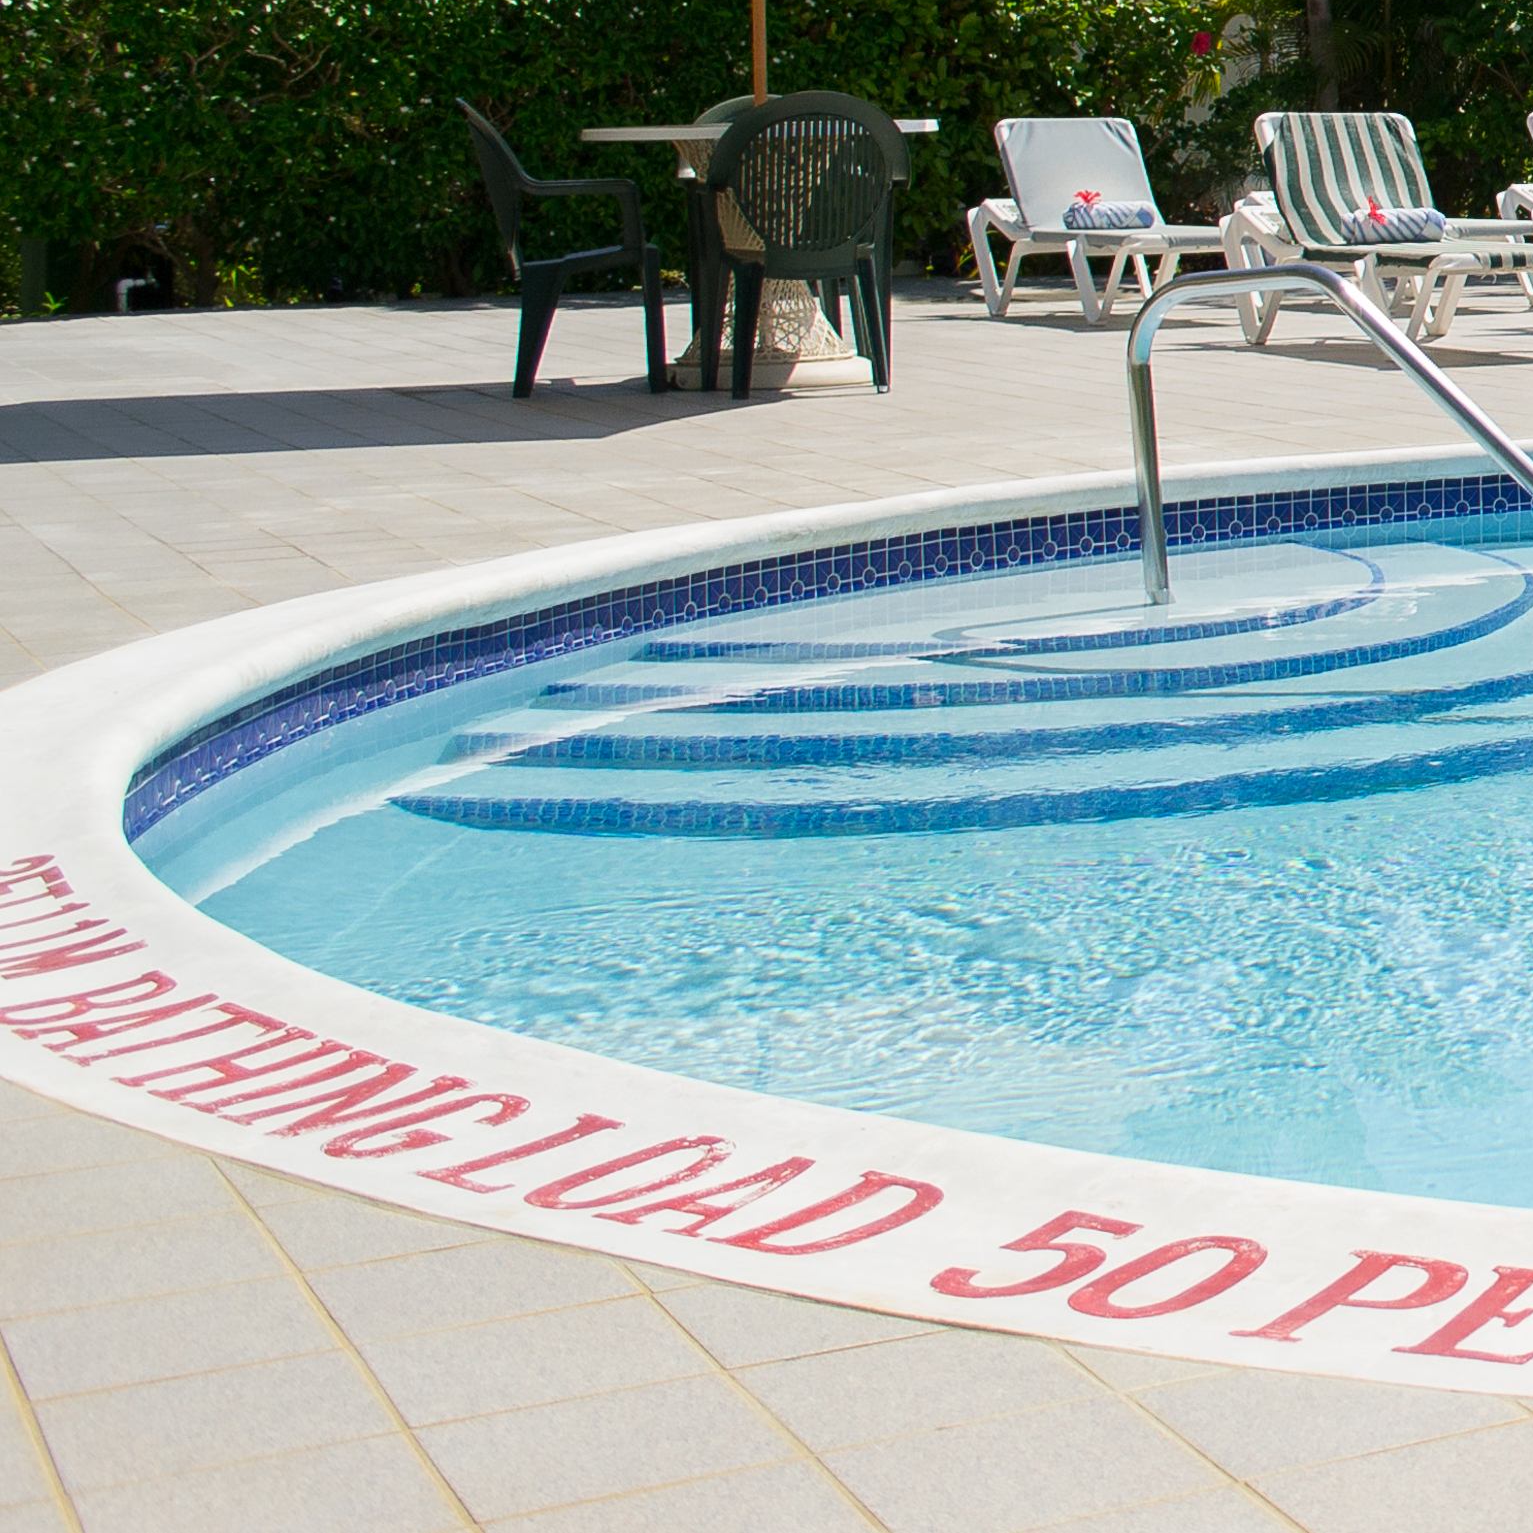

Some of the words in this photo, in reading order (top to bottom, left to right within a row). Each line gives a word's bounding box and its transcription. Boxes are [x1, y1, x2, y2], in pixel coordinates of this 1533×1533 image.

[0, 970, 530, 1158] BATHING
[417, 1114, 944, 1255] LOAD
[930, 1210, 1268, 1319] 50
